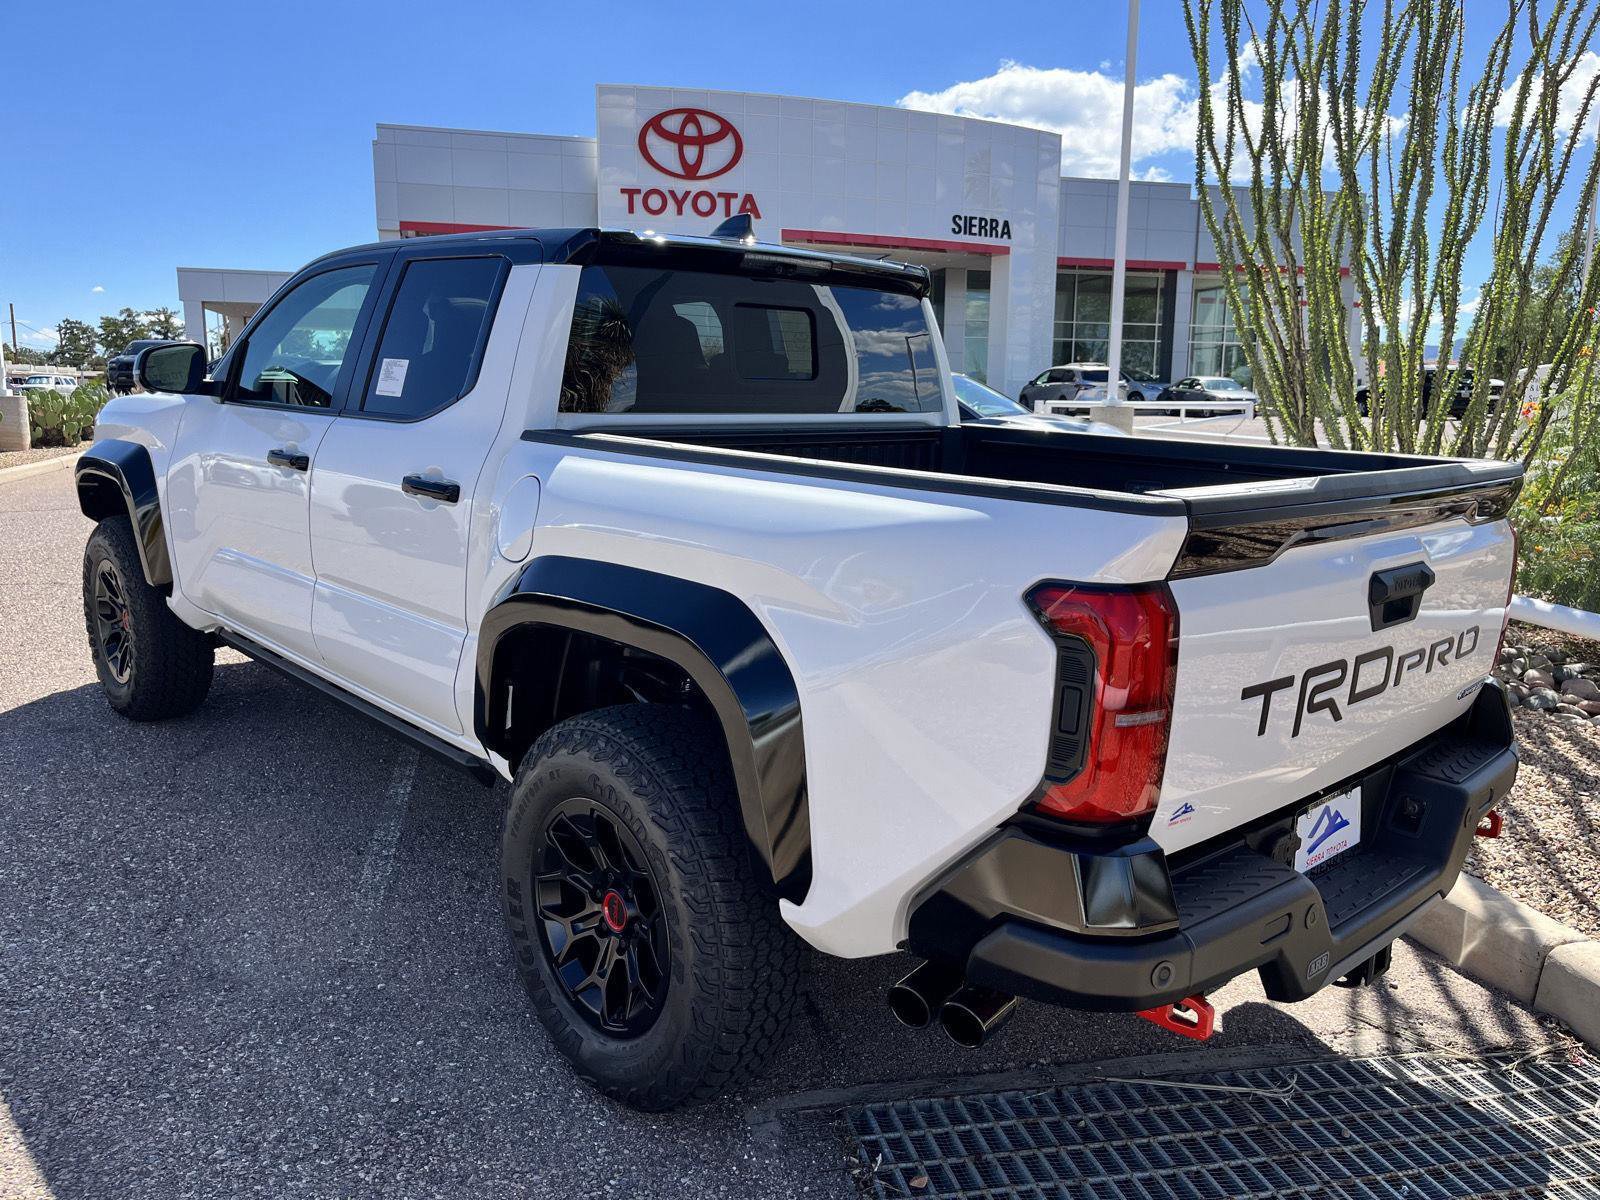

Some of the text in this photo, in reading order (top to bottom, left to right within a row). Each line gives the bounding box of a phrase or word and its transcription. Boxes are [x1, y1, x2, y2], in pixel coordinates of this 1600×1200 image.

[620, 188, 761, 219] TOYOTA
[951, 213, 1013, 240] SIERRA
[1240, 625, 1480, 738] TRD PRO
[1305, 839, 1349, 868] SIERRA TOYOTA
